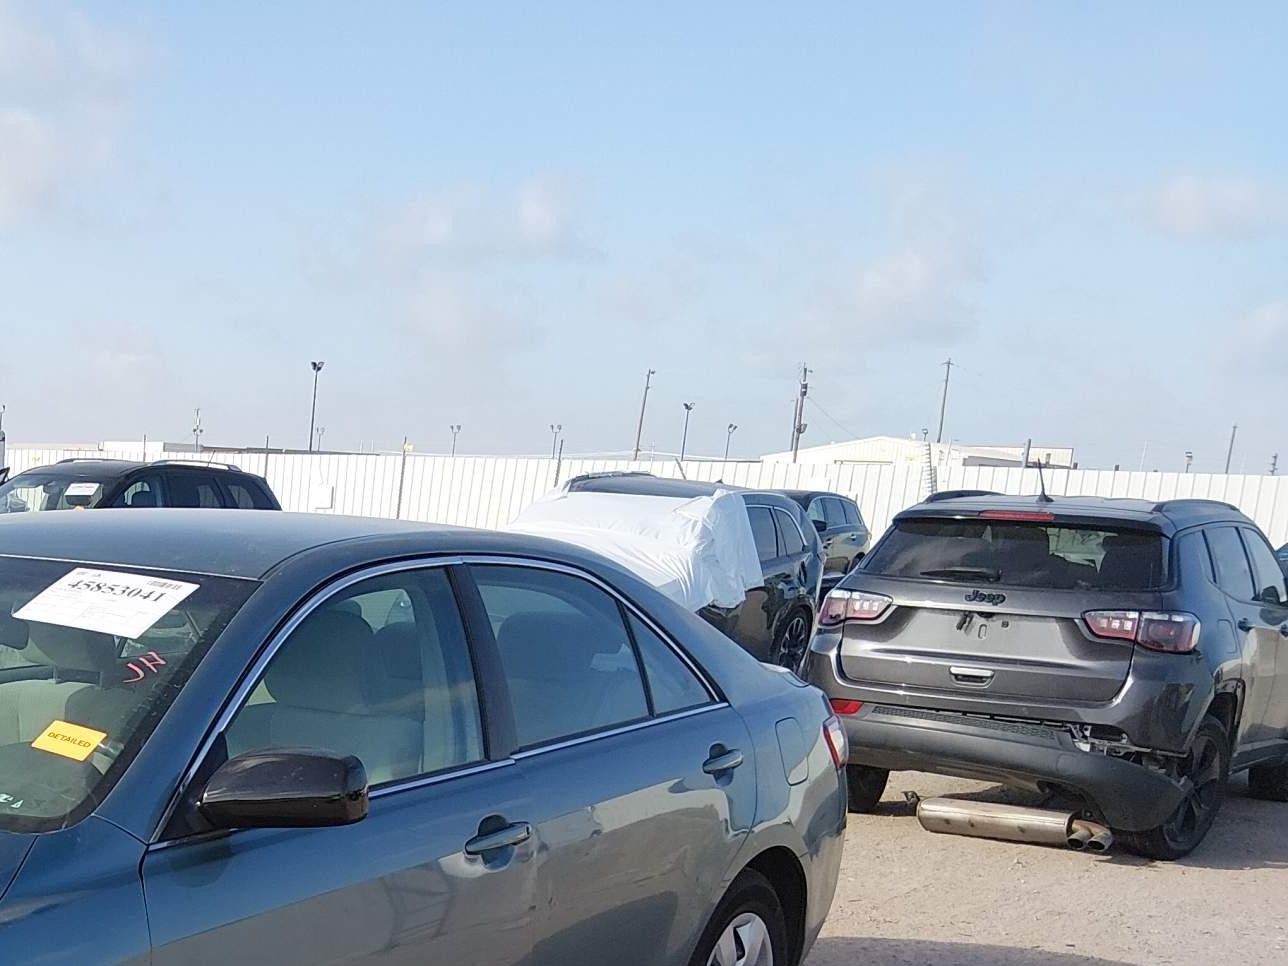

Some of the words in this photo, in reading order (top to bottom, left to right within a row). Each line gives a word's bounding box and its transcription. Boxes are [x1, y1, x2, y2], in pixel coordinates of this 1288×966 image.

[67, 579, 167, 602] 45853041
[965, 589, 1006, 606] Jeep
[47, 732, 91, 748] DETAILED
